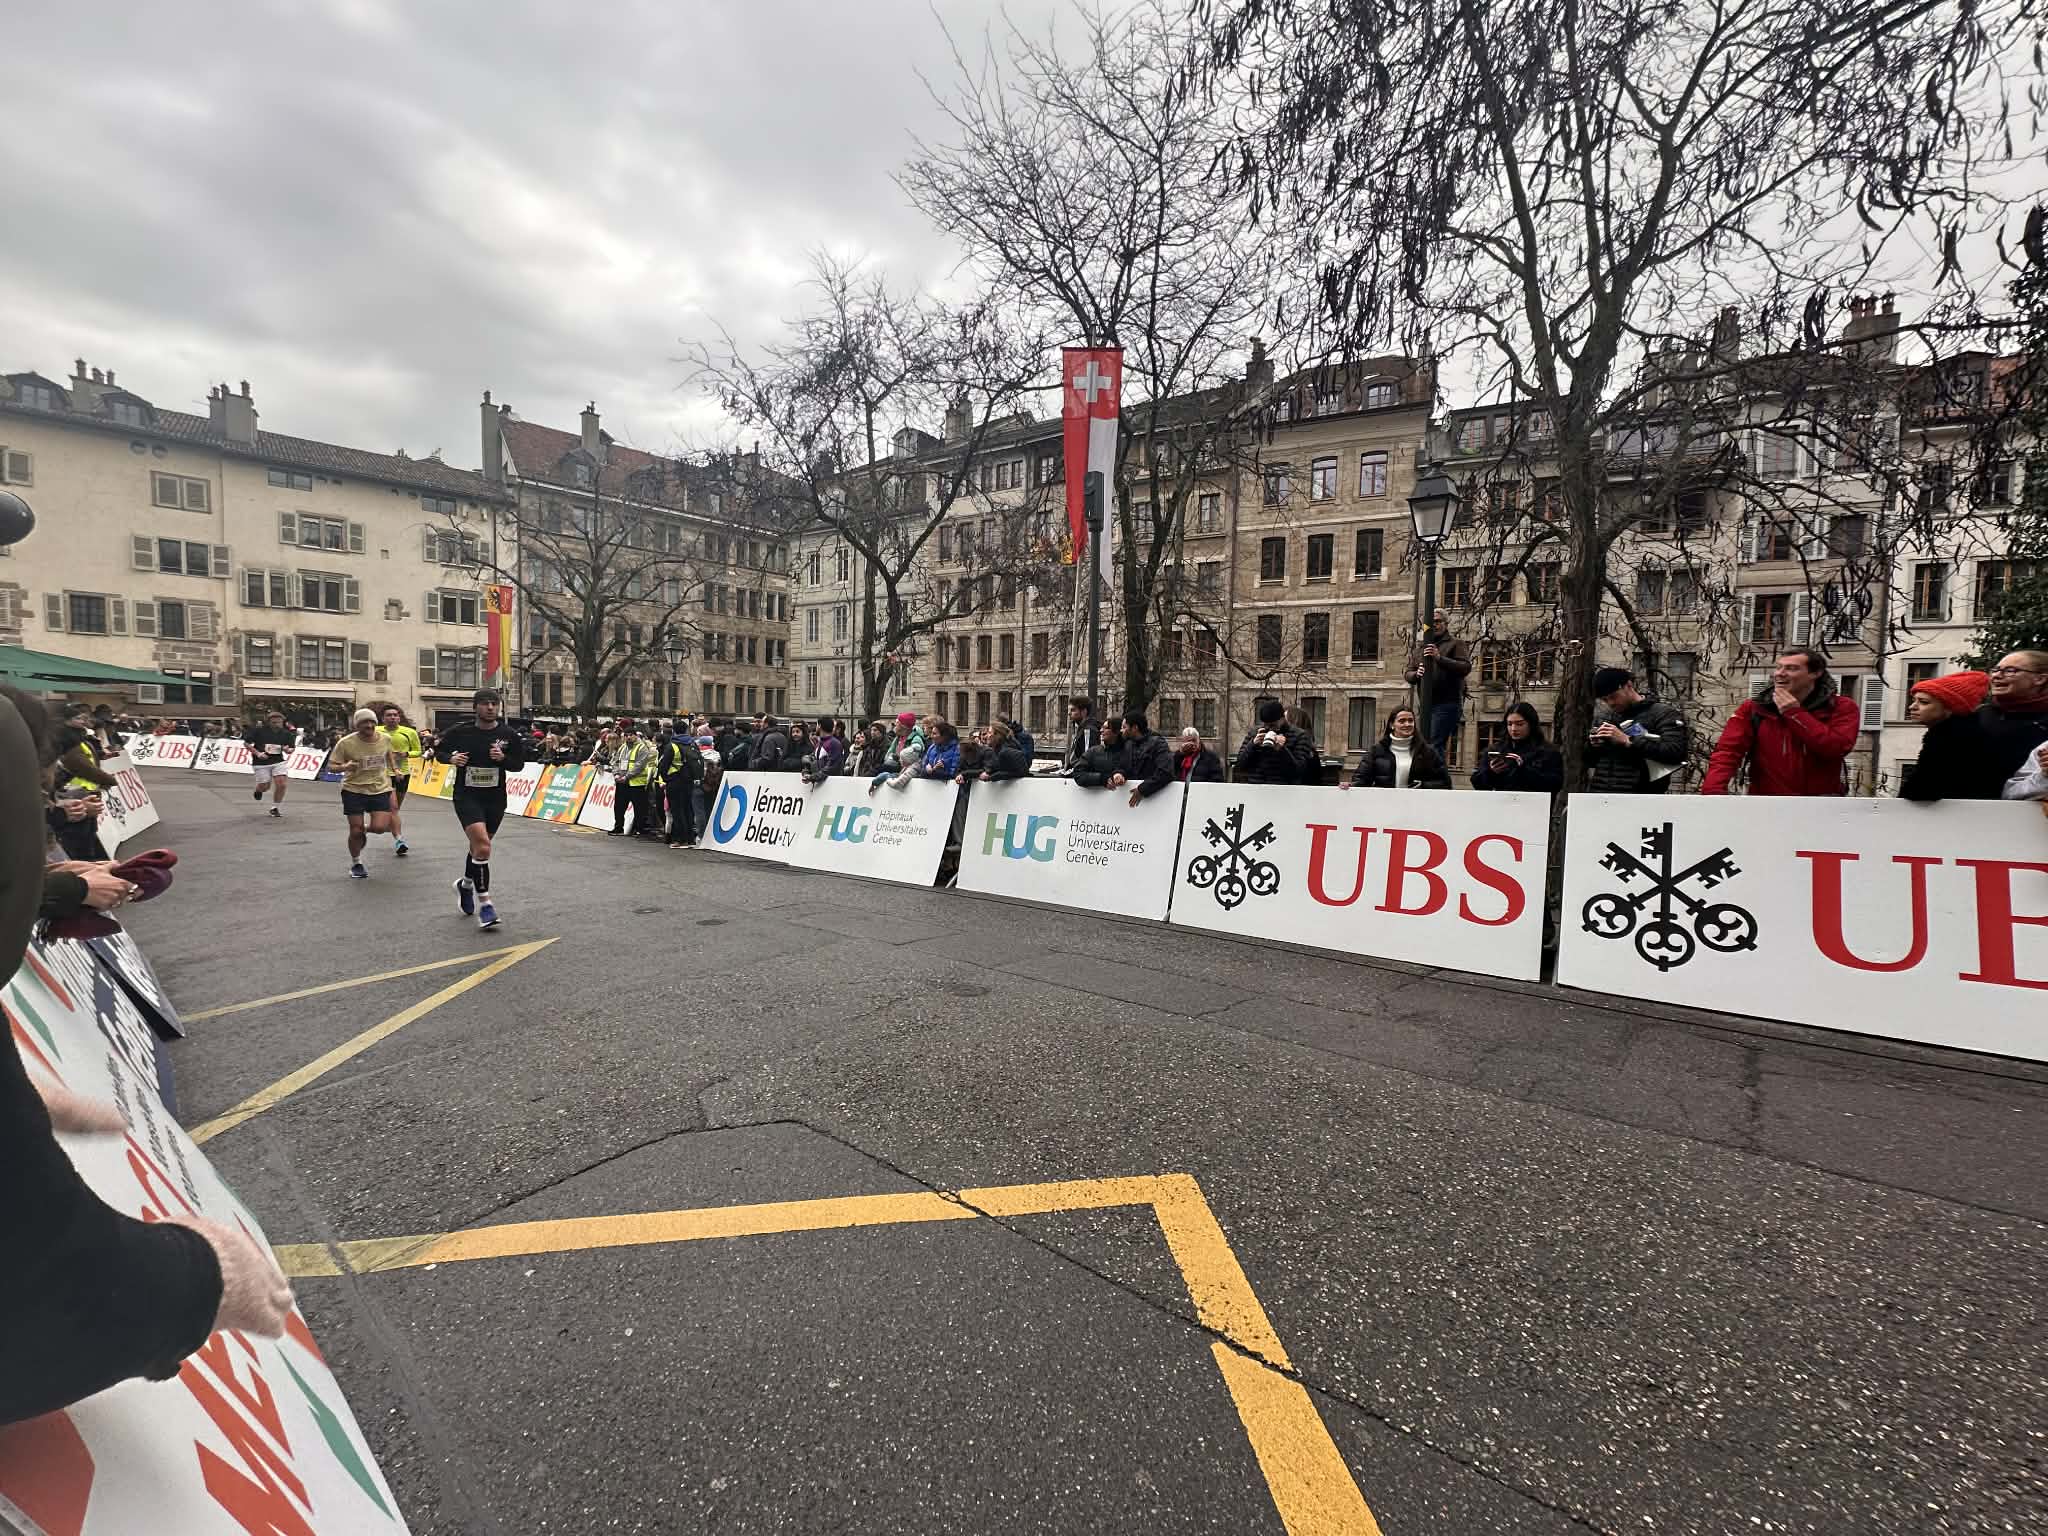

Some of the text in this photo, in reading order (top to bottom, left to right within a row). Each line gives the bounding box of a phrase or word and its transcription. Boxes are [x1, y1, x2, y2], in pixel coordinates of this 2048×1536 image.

[157, 741, 195, 760] UBS
[222, 746, 253, 766] UB
[113, 767, 149, 811] UBS
[506, 777, 535, 798] IGROS
[752, 786, 804, 817] léman
[814, 804, 873, 844] HUG
[878, 809, 914, 823] Hôpitaux
[875, 821, 928, 836] Universitaires
[982, 812, 1060, 863] HUG
[1070, 819, 1121, 837] Hôpitaux
[872, 833, 903, 846] Genève
[1068, 836, 1145, 854] Universitaires
[1066, 849, 1109, 866] Genève
[1305, 823, 1527, 927] UBS
